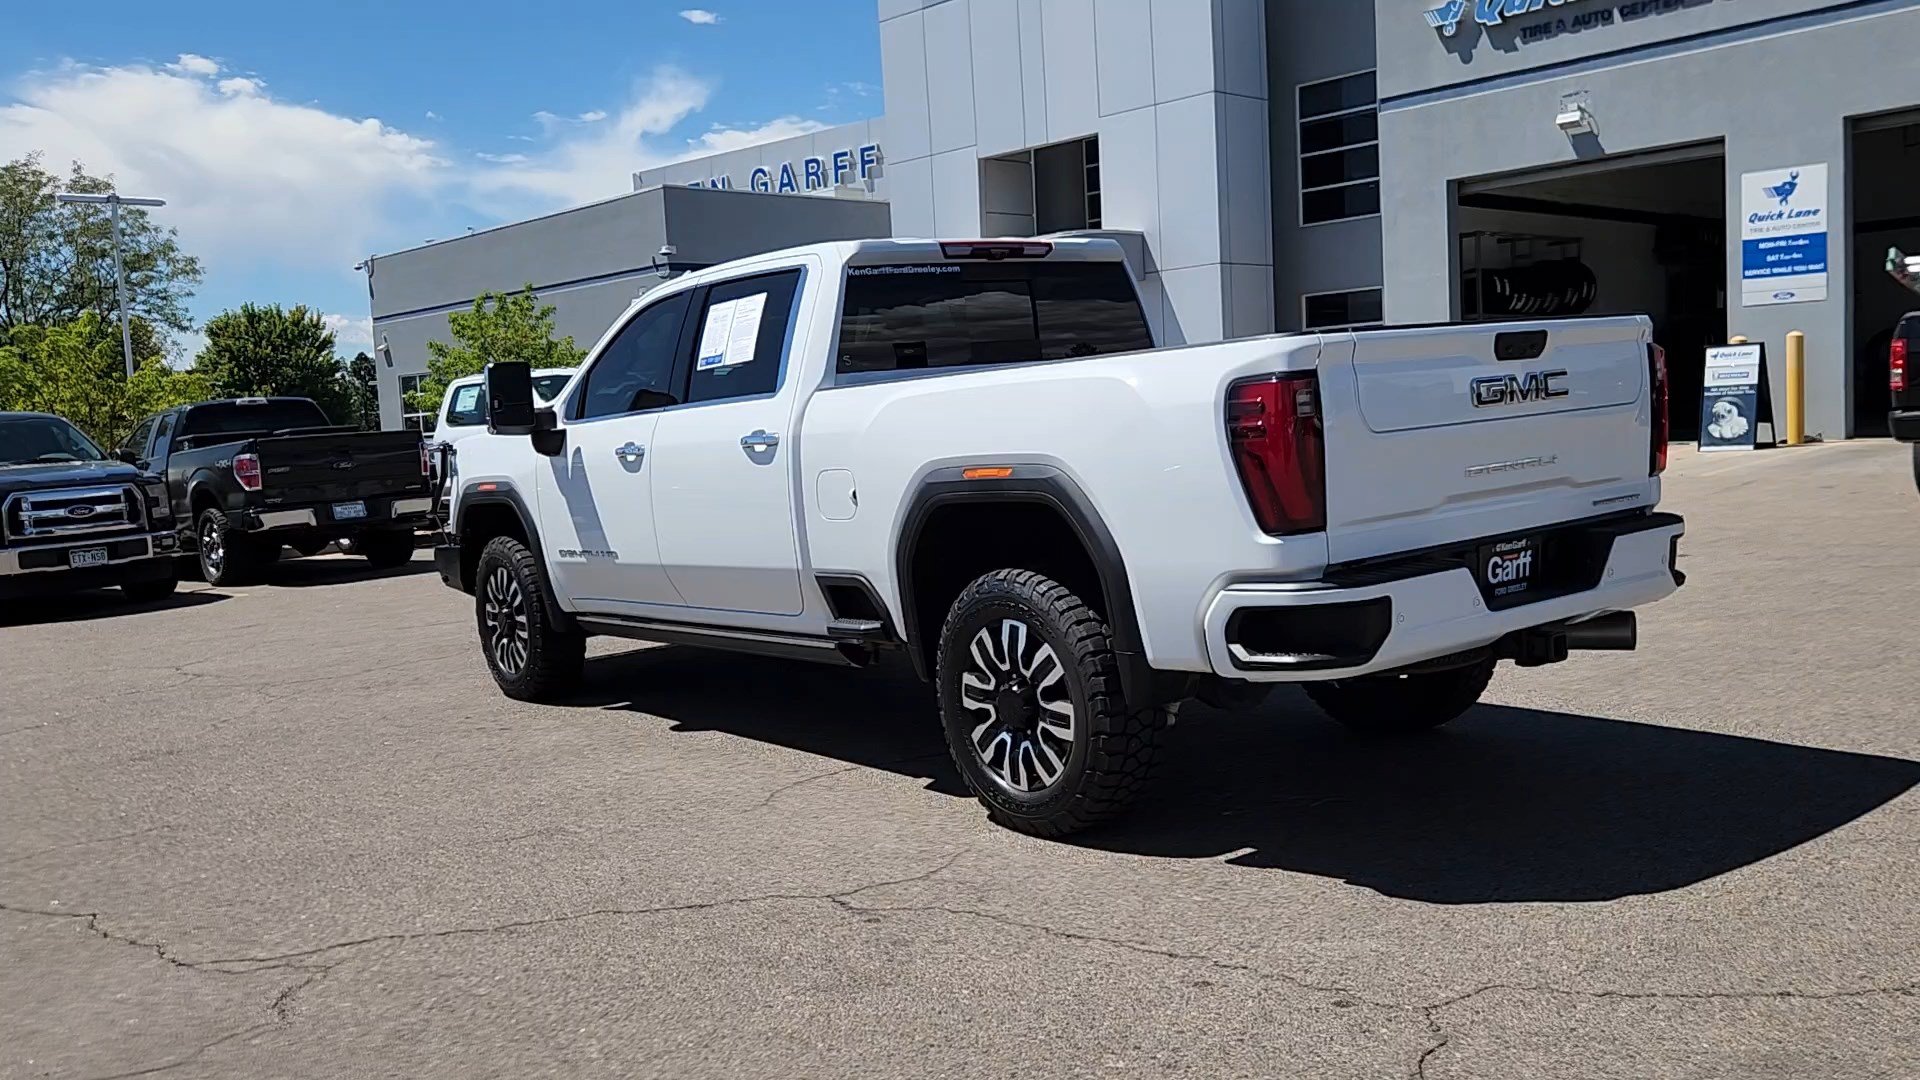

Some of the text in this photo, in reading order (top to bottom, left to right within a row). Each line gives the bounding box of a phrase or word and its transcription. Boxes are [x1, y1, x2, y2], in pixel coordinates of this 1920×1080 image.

[1520, 22, 1553, 40] TIRE
[1571, 9, 1613, 29] AUTO
[750, 143, 878, 195] GARFF
[1748, 208, 1821, 224] Quick Lane
[1470, 368, 1569, 408] GMC
[73, 507, 90, 516] Ford
[1487, 549, 1532, 584] Garff
